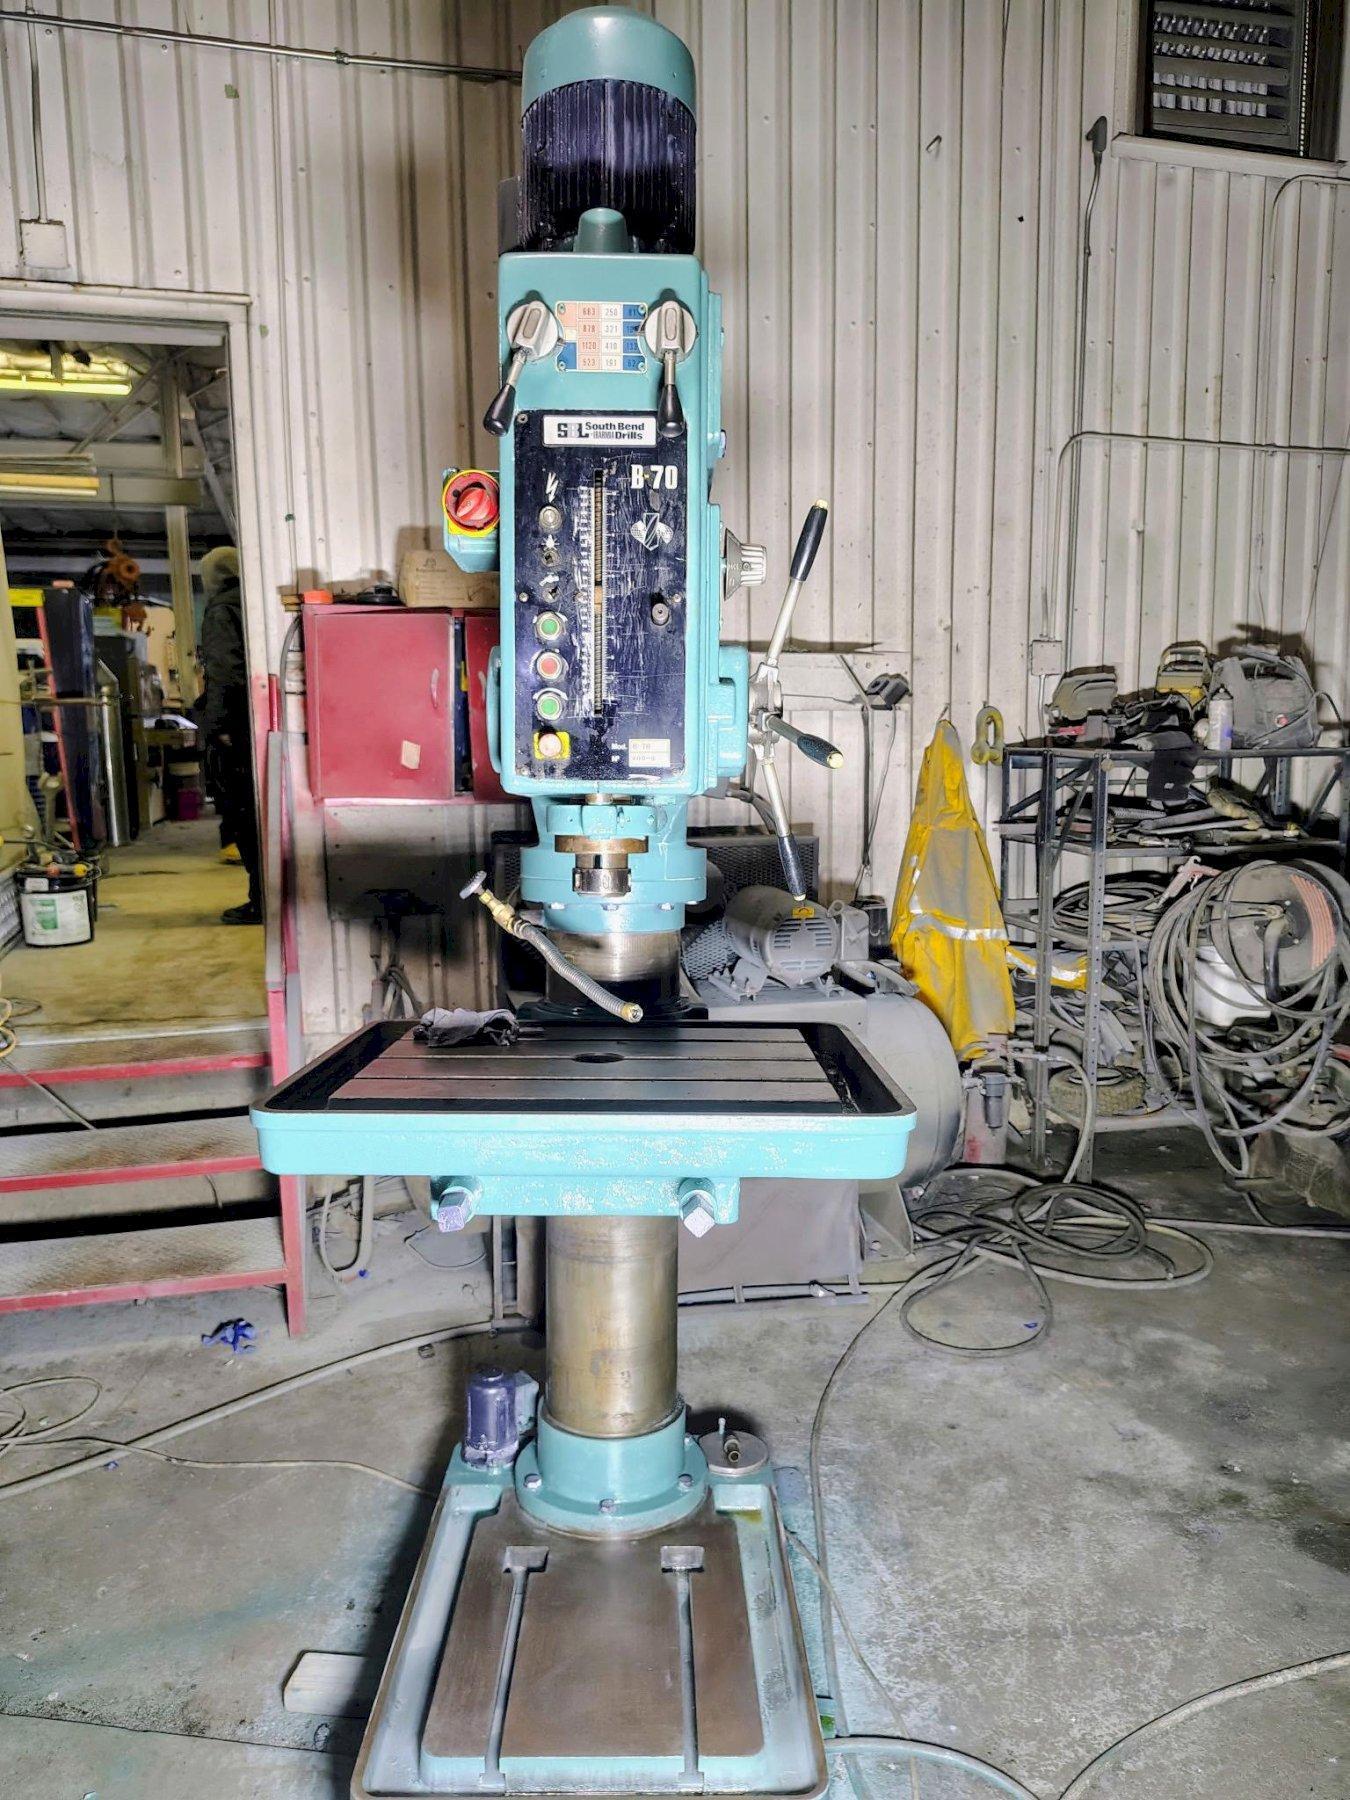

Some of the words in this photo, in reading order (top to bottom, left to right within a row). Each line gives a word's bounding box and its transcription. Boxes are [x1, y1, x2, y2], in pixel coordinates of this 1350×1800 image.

[585, 421, 616, 431] South
[618, 422, 645, 431] Bend
[615, 431, 643, 440] Drills
[631, 464, 678, 489] B-70
